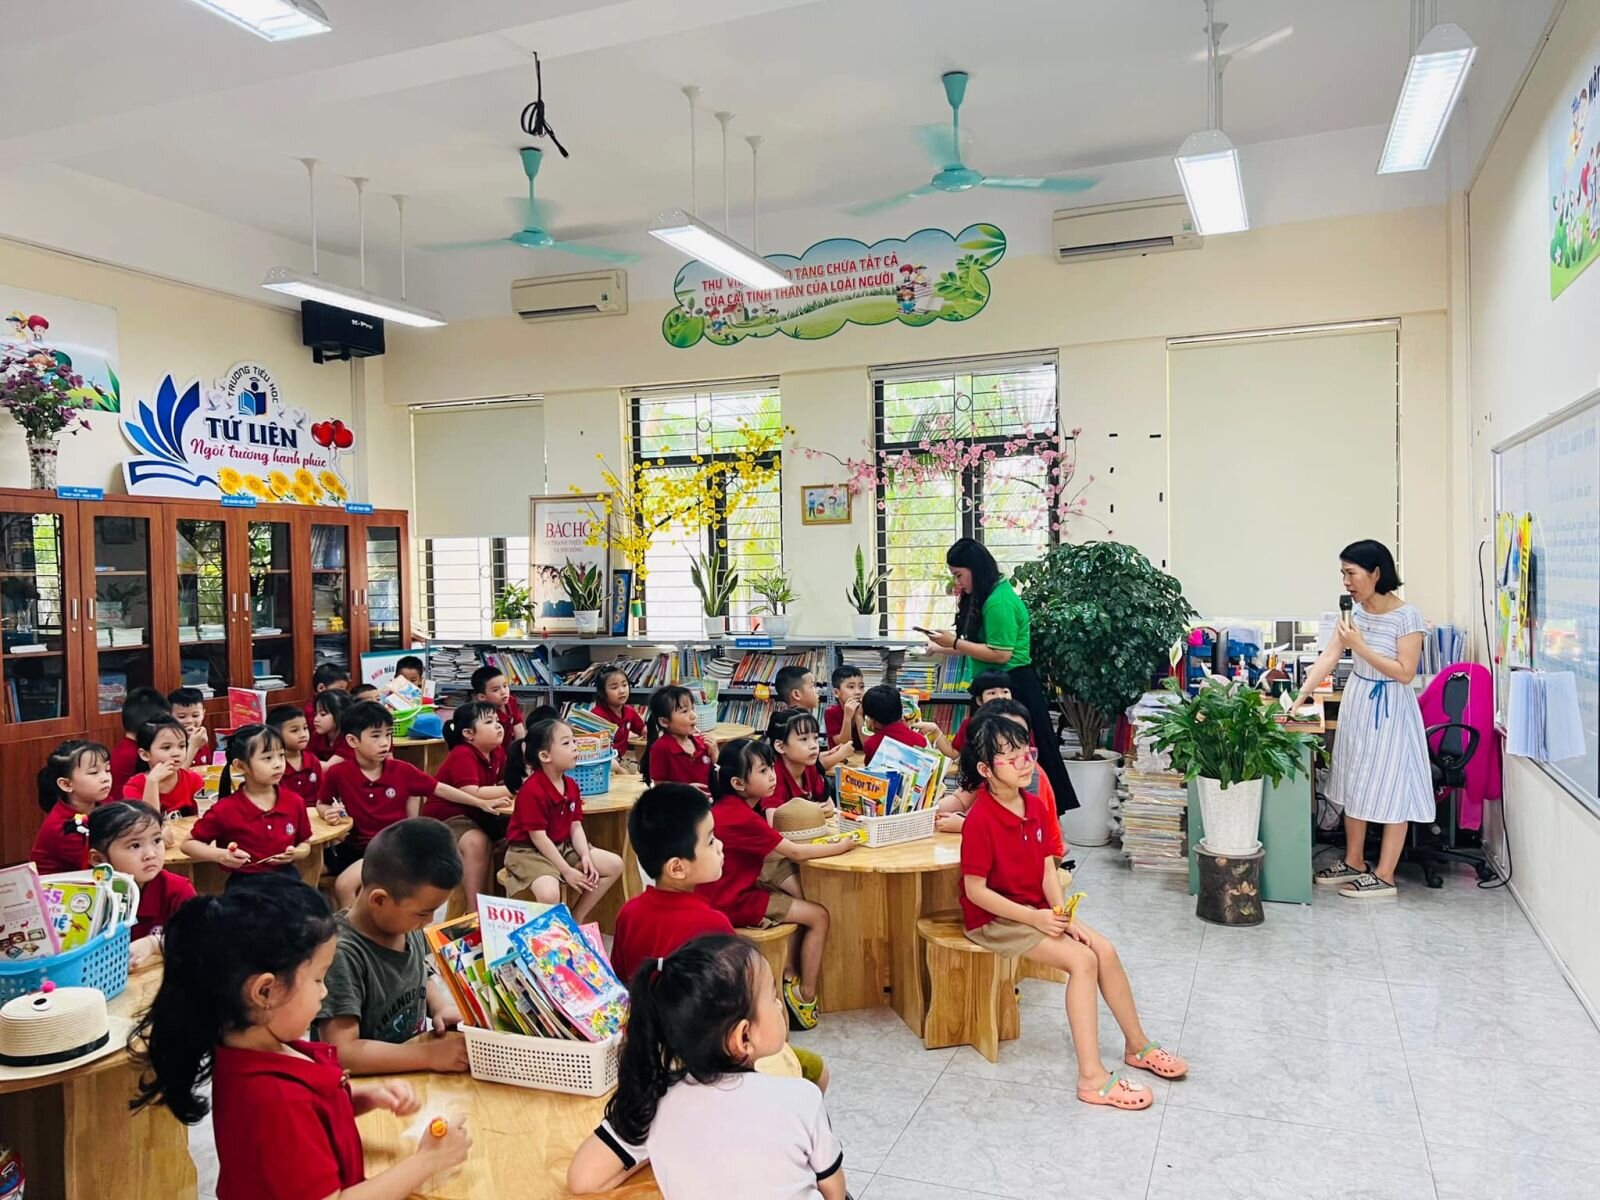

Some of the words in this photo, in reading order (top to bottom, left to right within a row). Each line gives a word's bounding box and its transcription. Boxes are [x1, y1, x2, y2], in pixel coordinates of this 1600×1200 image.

[205, 415, 243, 441] TỨ
[248, 421, 298, 449] LIÊN
[190, 438, 225, 460] Ngôi
[229, 444, 270, 466] trường
[272, 448, 301, 467] hạnh
[302, 453, 327, 470] phúc
[546, 520, 572, 538] BÁC
[486, 905, 526, 925] BOB
